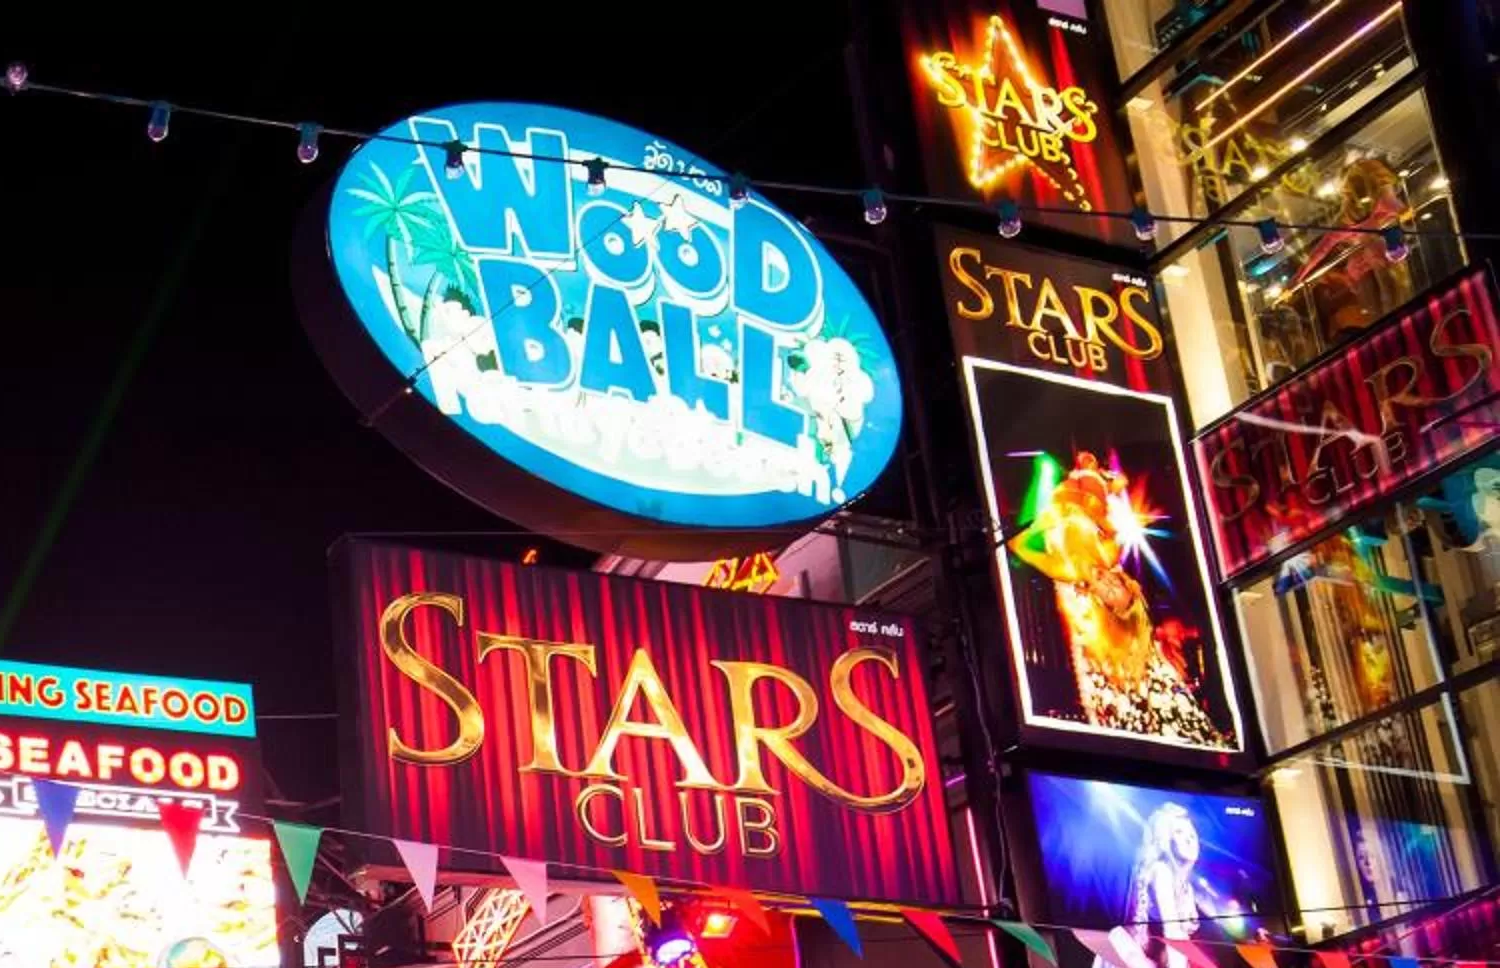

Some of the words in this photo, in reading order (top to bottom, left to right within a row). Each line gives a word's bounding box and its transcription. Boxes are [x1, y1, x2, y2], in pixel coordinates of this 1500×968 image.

[930, 52, 1098, 143] STARS
[980, 120, 1064, 162] CLUB
[409, 116, 823, 332] WOOD
[949, 247, 1164, 360] STARS
[476, 256, 807, 447] BALL
[1027, 331, 1108, 372] CLUB
[74, 677, 249, 725] SEAFOOD
[379, 591, 926, 815] STARS
[576, 784, 781, 859] CLUB
